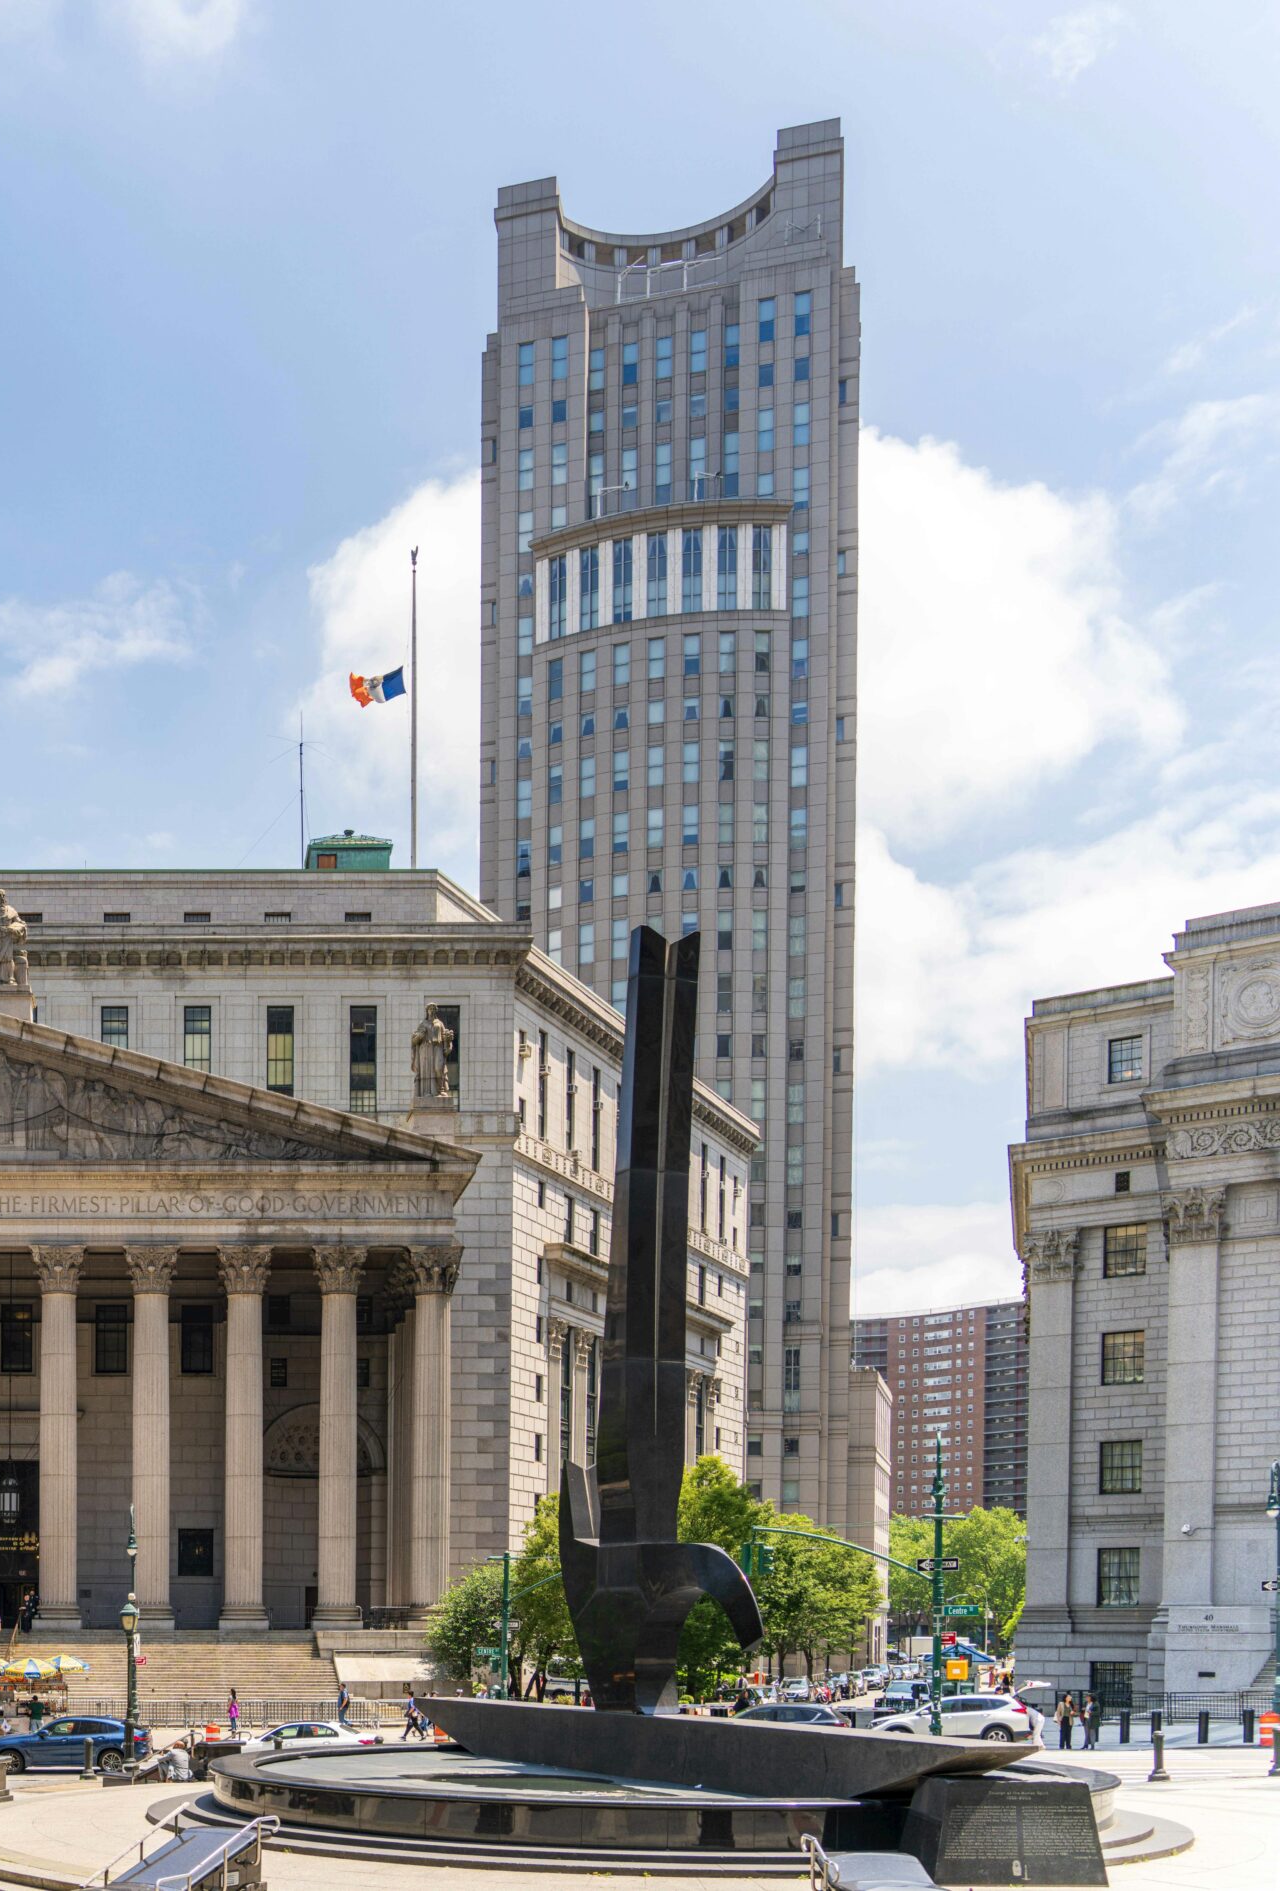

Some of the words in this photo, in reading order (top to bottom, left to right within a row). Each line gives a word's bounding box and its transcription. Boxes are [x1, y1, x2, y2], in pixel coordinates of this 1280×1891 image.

[30, 1195, 112, 1213] FIRMEST
[120, 1195, 180, 1213] PILLAR
[188, 1195, 215, 1213] OF
[222, 1195, 284, 1213] GOOD
[292, 1195, 435, 1214] GOVERNMENT
[948, 1606, 968, 1615] Centre
